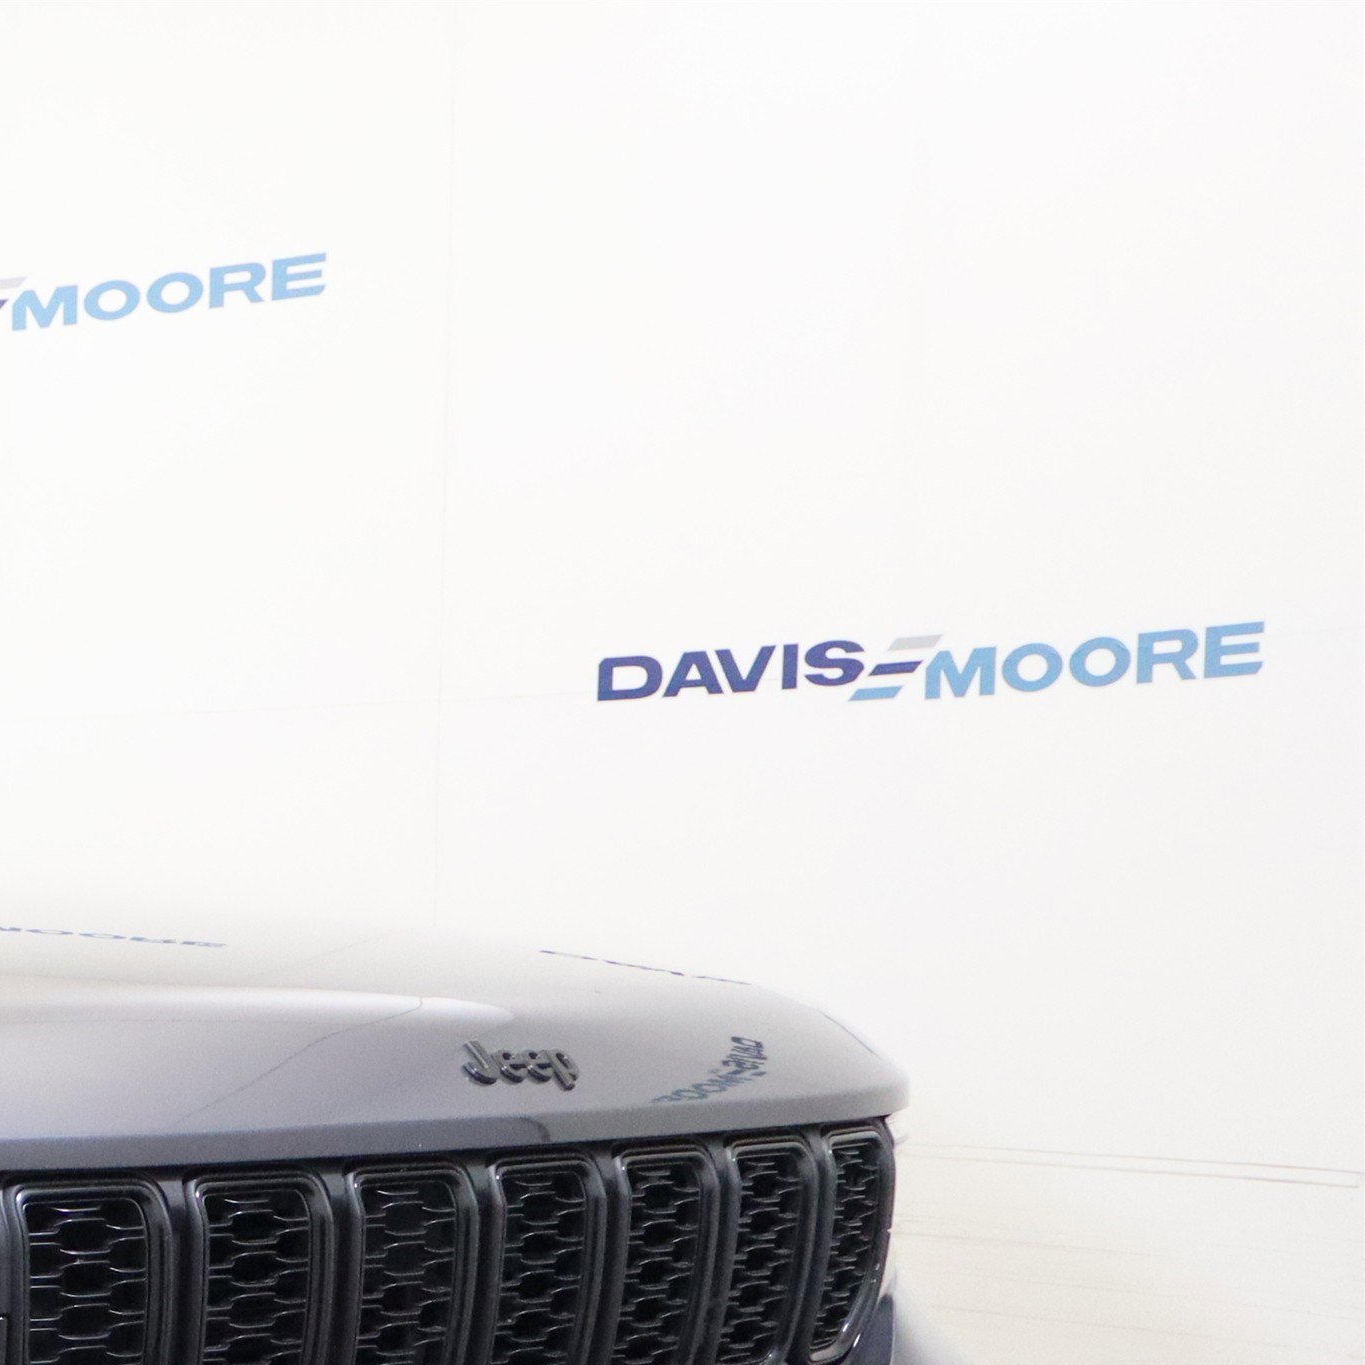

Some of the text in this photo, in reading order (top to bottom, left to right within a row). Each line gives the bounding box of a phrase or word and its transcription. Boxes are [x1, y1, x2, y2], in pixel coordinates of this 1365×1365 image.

[12, 252, 326, 332] MOORE
[597, 621, 1265, 702] DAVIS MOORE
[461, 1040, 580, 1092] Jeep
